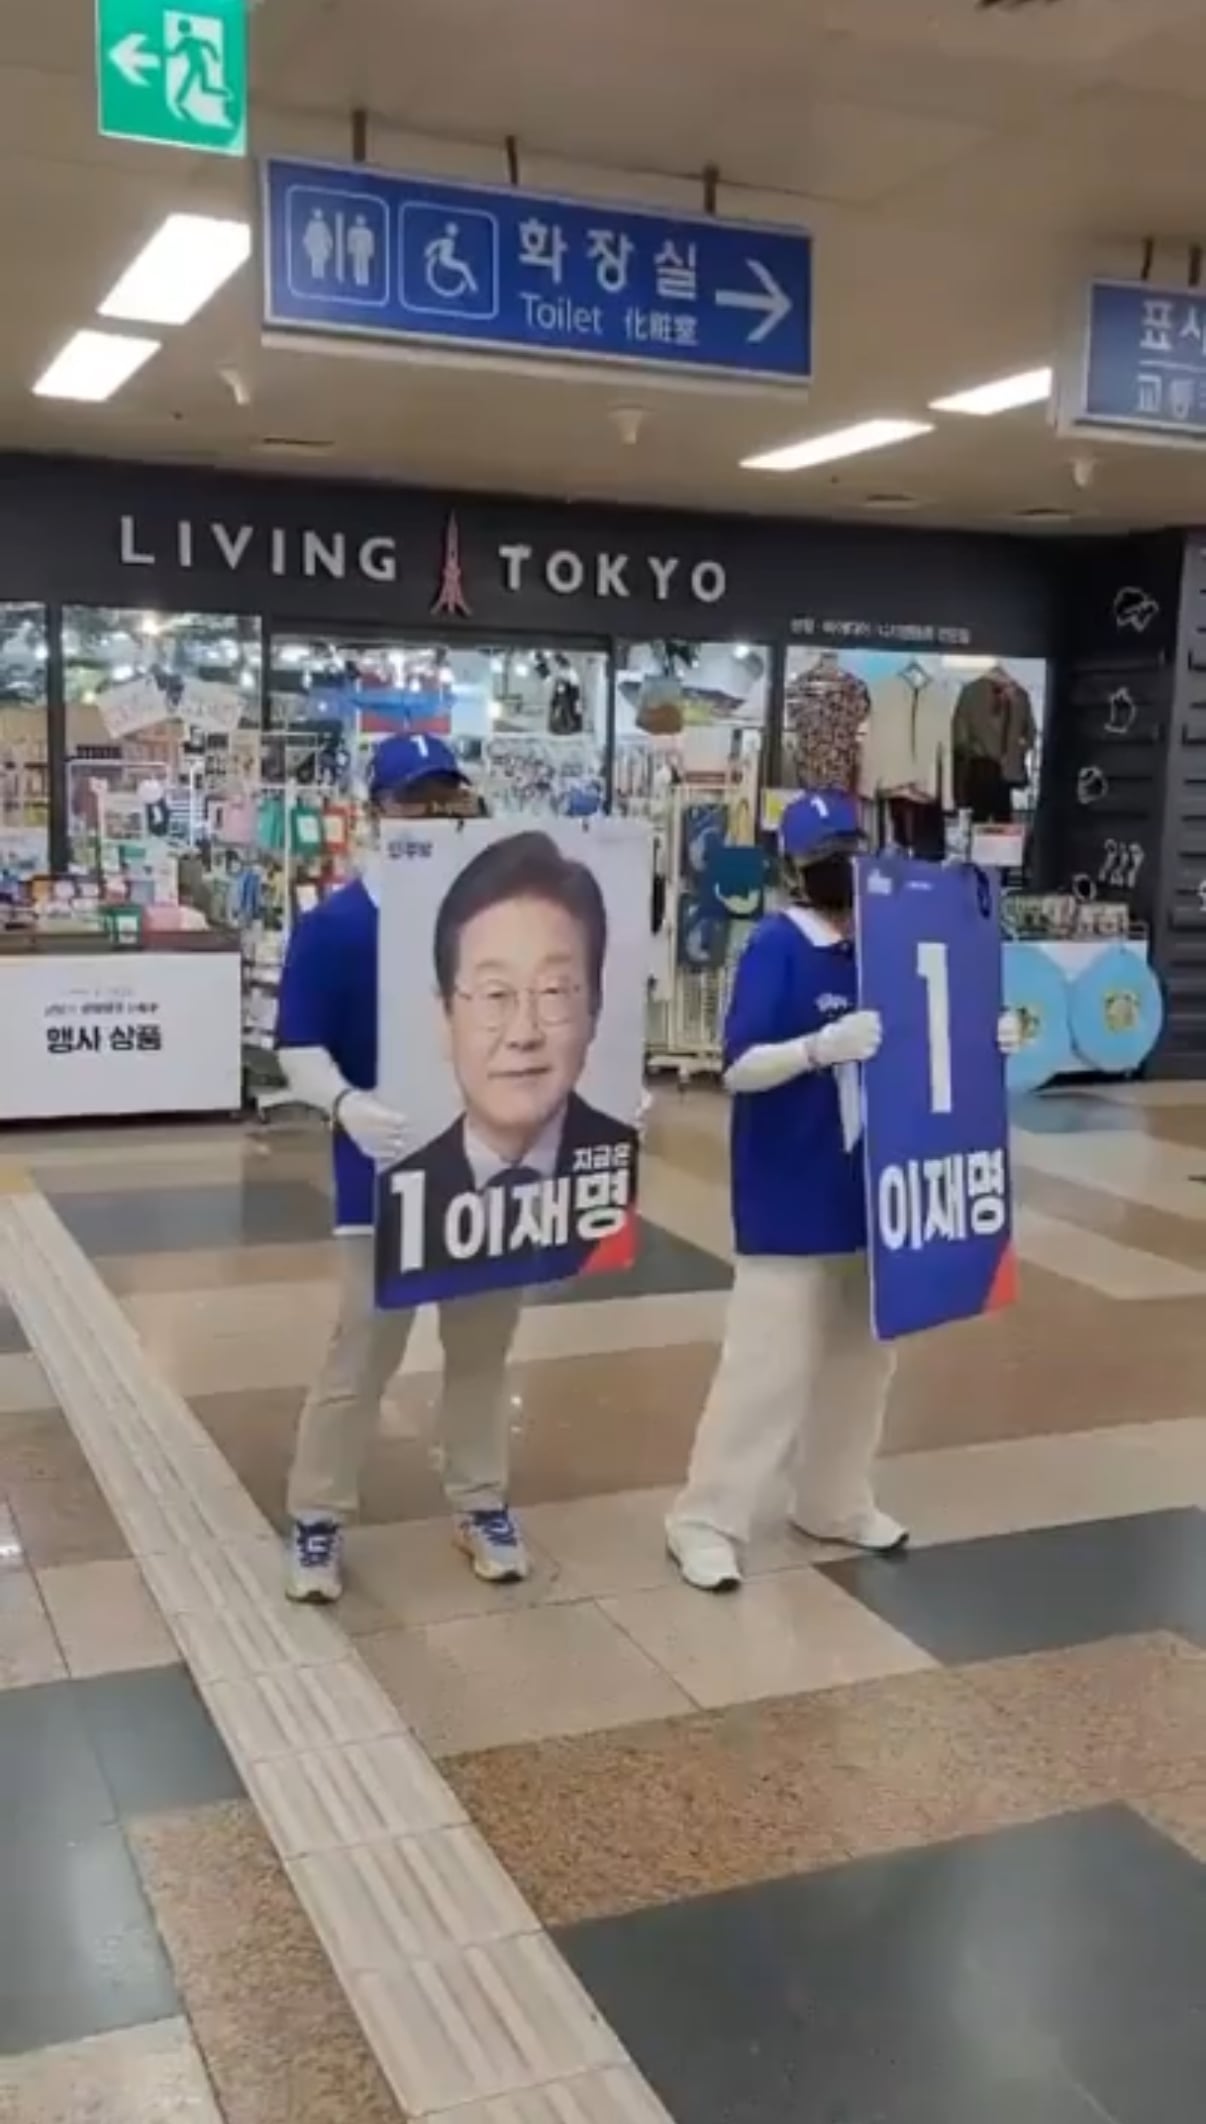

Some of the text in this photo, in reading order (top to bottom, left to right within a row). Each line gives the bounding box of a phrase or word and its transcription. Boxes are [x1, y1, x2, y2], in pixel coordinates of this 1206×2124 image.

[518, 217, 697, 300] 화장실
[519, 291, 604, 335] Toilet
[121, 516, 727, 602] LIVING TOKYO
[410, 734, 429, 757] 1
[810, 795, 829, 817] 1
[46, 1025, 162, 1053] 행사 상품
[916, 942, 953, 1114] 1
[573, 1143, 632, 1171] 지금은
[391, 1170, 629, 1274] 1 이재명
[878, 1148, 1004, 1251] 이재명
